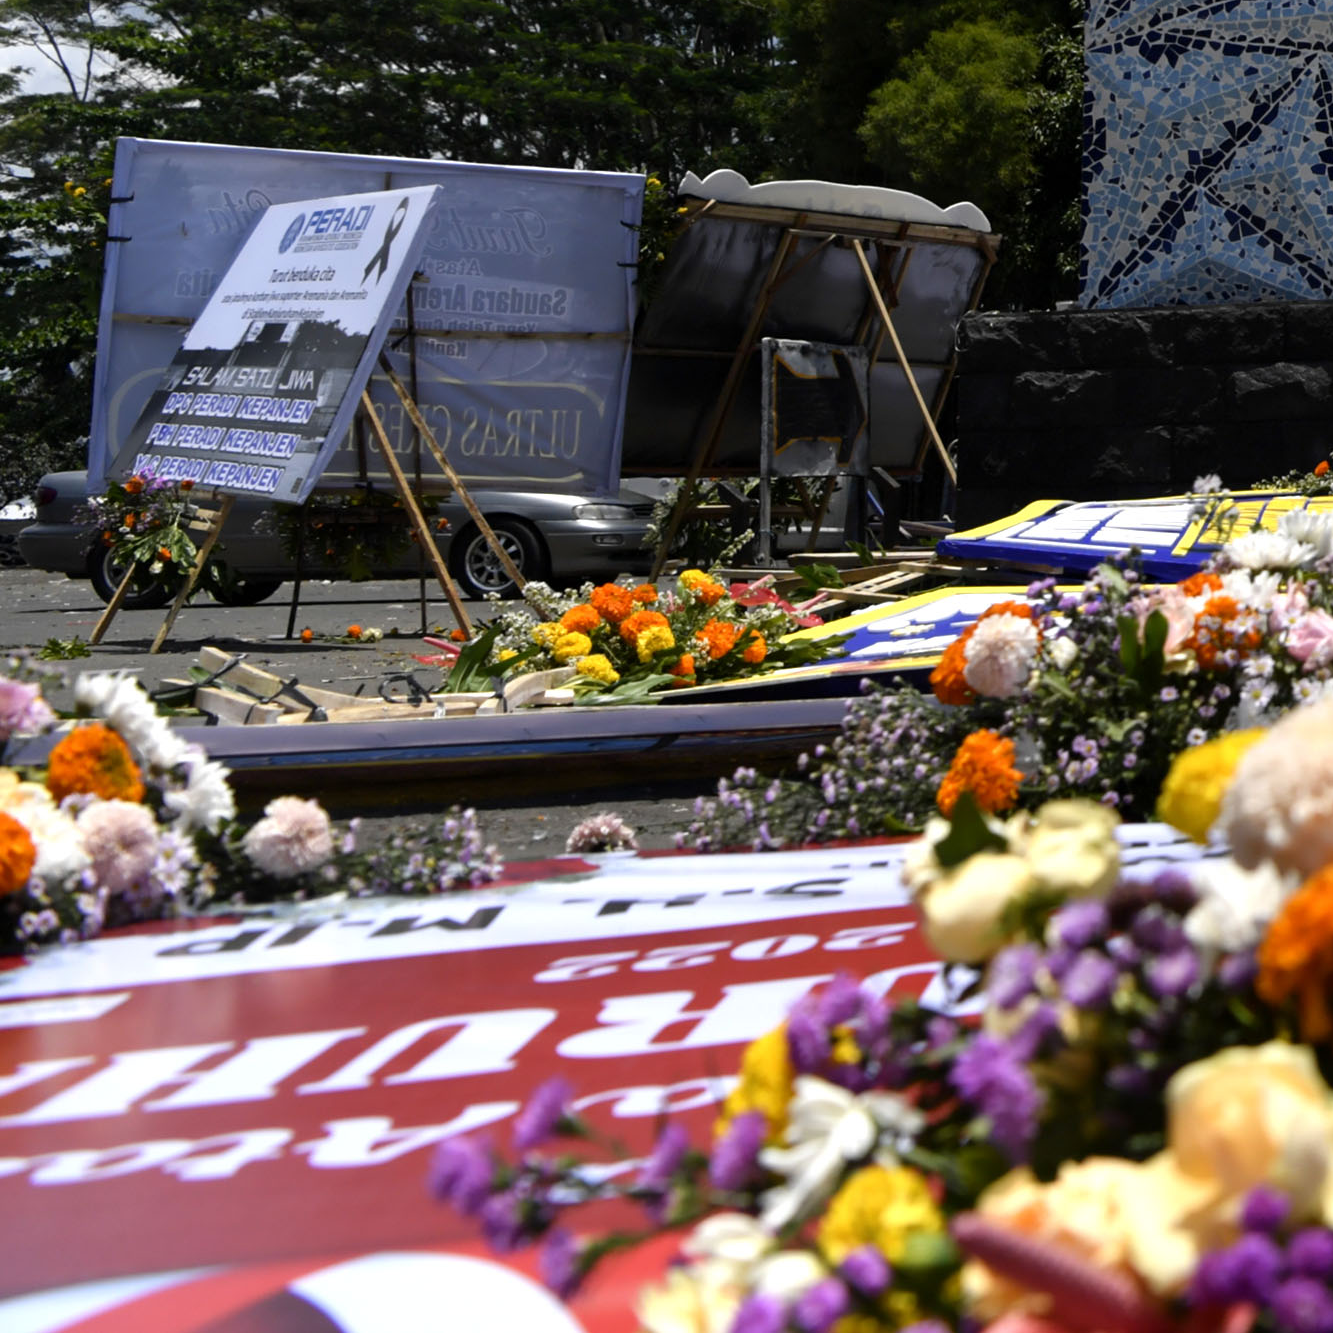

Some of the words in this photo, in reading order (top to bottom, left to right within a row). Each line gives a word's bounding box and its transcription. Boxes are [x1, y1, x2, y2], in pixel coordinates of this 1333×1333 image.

[302, 205, 376, 235] PERADI
[318, 266, 336, 281] cita
[182, 367, 235, 387] SALAM
[232, 368, 279, 389] SATU
[277, 370, 314, 390] JIWA
[162, 392, 194, 415] DPC
[189, 393, 243, 418] PERADI
[236, 395, 317, 424] KEPANJEN
[146, 423, 178, 446] PBH
[172, 425, 227, 451] PERADI
[220, 428, 301, 459] KEPANJEN
[155, 456, 210, 483] PERADI
[204, 460, 285, 494] KEPANJEN
[533, 922, 917, 983] 2022
